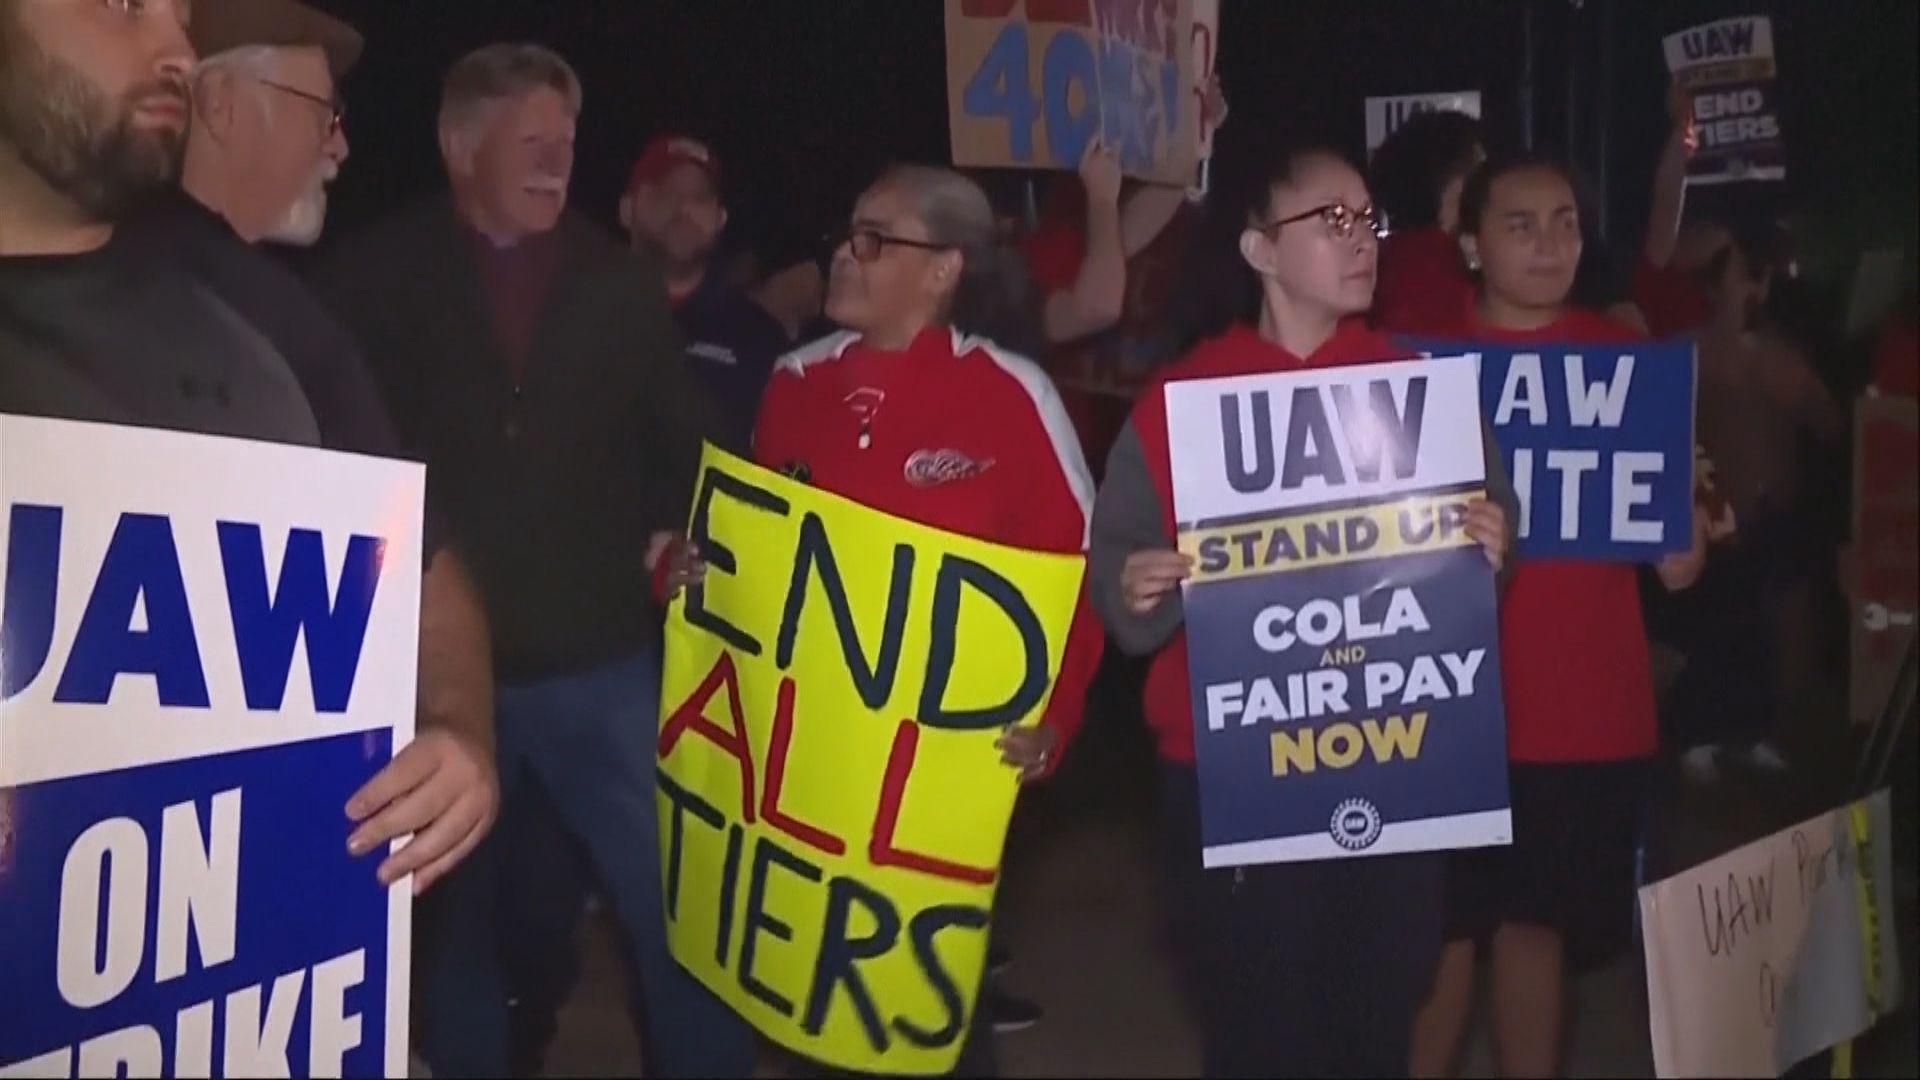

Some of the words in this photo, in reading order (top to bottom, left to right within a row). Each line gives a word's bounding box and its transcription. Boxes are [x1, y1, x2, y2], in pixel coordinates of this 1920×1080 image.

[1682, 21, 1755, 59] UAW
[963, 19, 1100, 169] 40
[1693, 87, 1763, 120] END
[1463, 353, 1635, 427] AW
[1219, 376, 1428, 494] UAW
[1199, 515, 1379, 573] STAND
[1400, 502, 1469, 547] UP
[1513, 447, 1664, 542] ITE
[685, 466, 1049, 730] END
[1252, 587, 1430, 652] COLA
[1205, 669, 1350, 731] FAIR
[1364, 648, 1487, 708] PAY
[1319, 645, 1366, 667] AND
[657, 650, 996, 884] ALL
[1269, 712, 1428, 776] NOW
[56, 787, 242, 1009] ON
[656, 766, 991, 1053] TIERS
[1697, 856, 1775, 956] UAW
